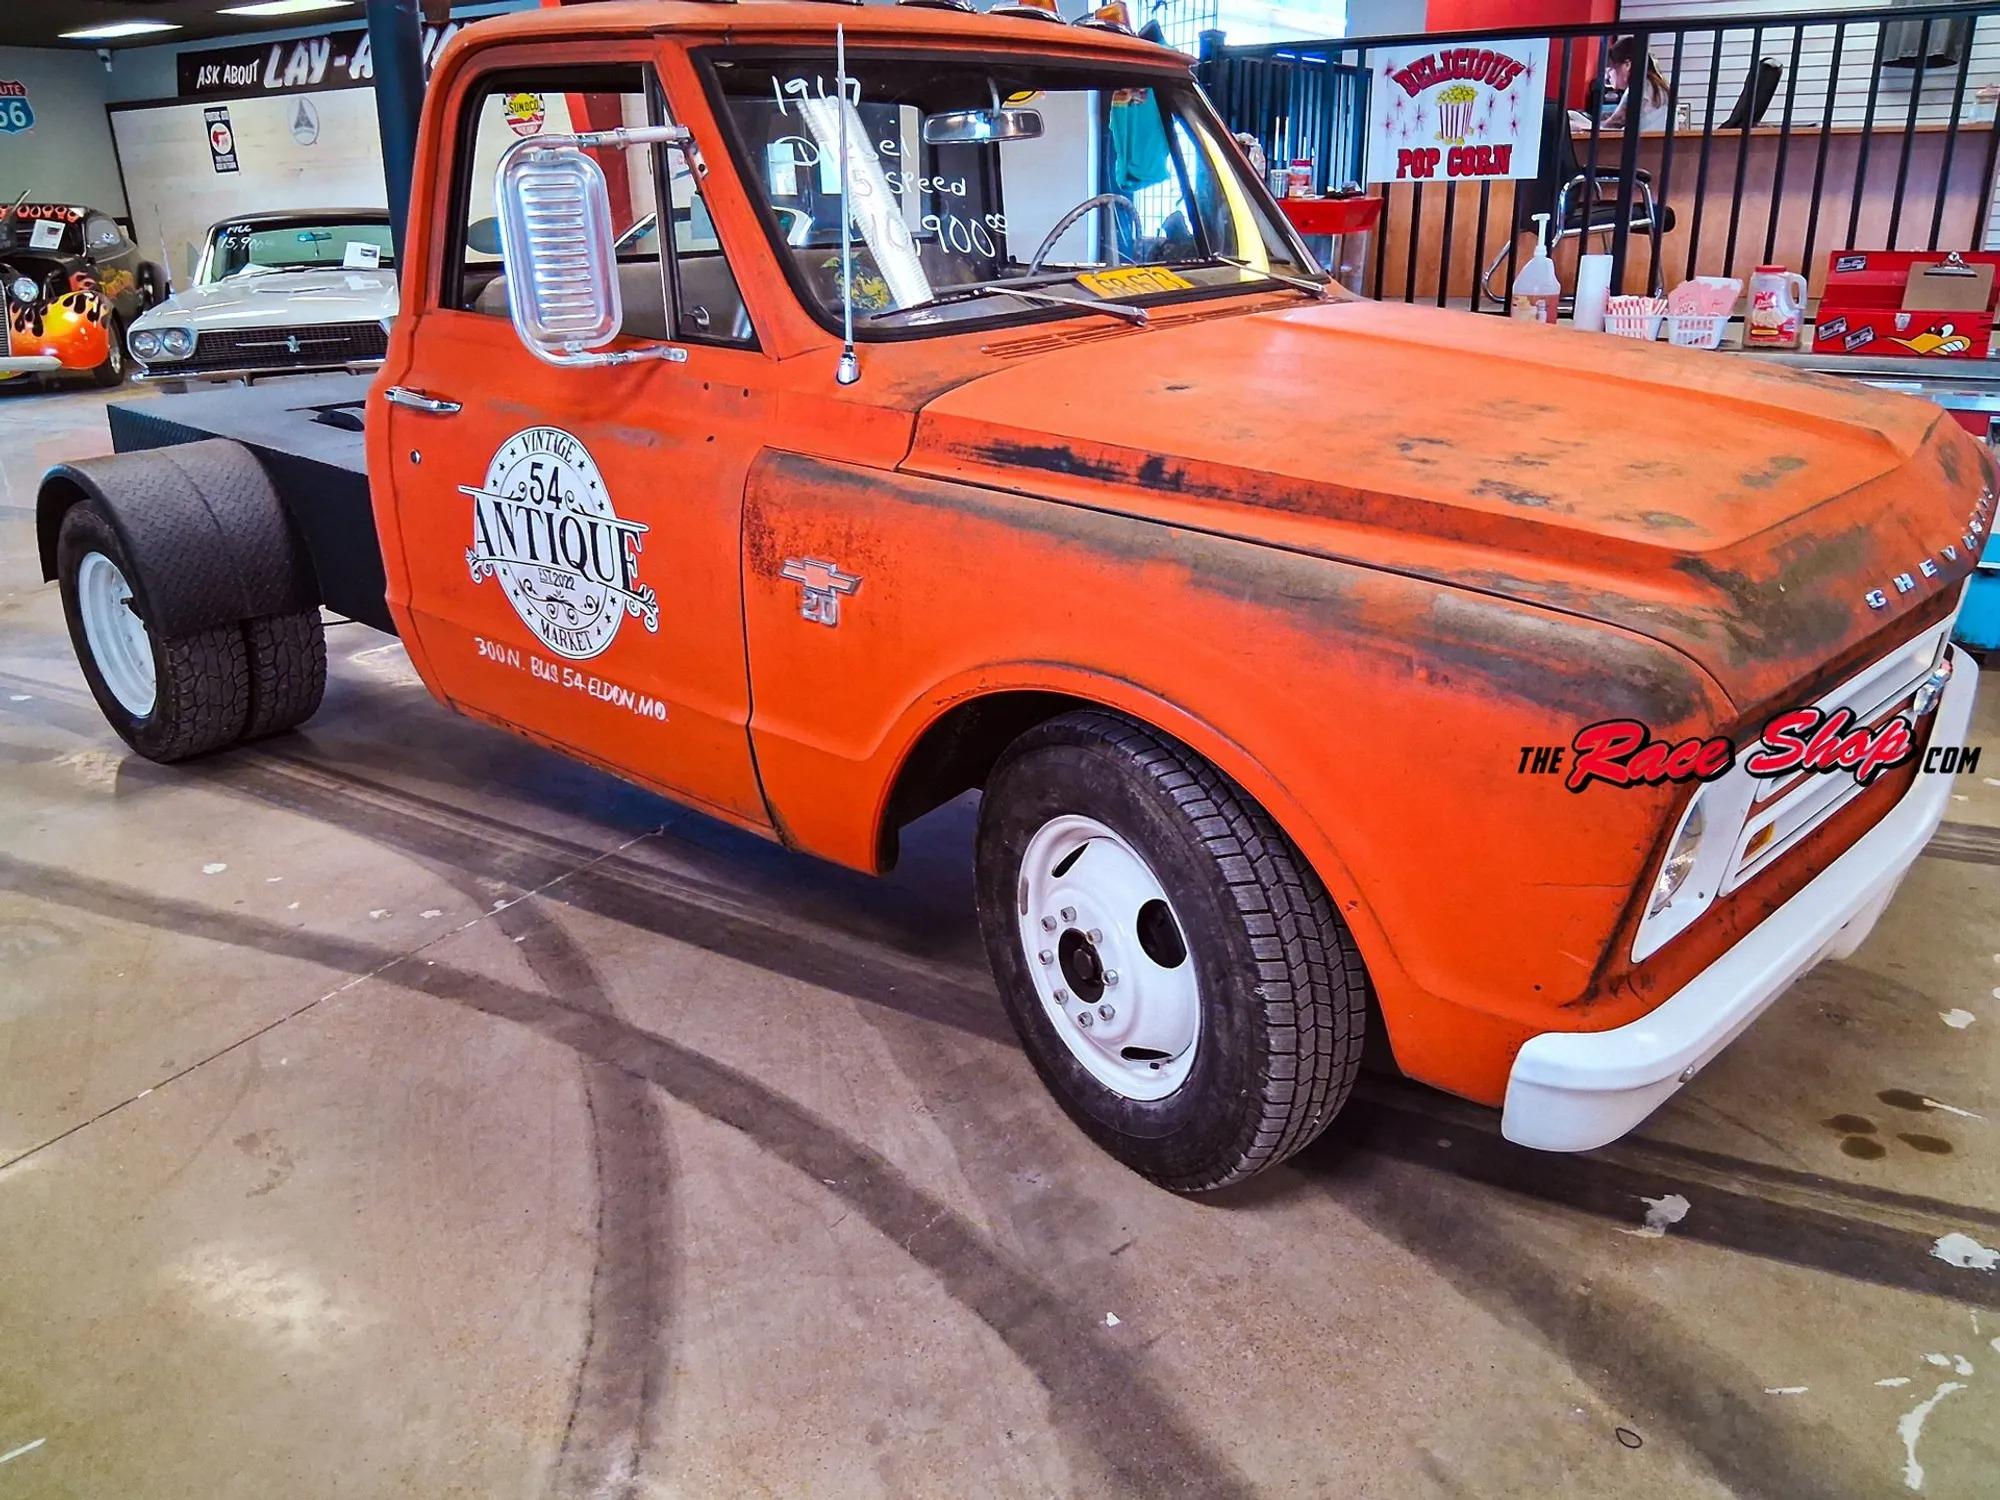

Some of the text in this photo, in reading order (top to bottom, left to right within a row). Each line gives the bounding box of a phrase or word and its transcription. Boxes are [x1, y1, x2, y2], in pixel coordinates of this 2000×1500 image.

[196, 66, 220, 89] ASK
[223, 59, 260, 86] ABOUT
[1391, 48, 1527, 98] DELICIOUS
[508, 99, 539, 114] SUNOCO
[1396, 144, 1513, 179] POP CORN
[521, 431, 577, 464] VINTAGE
[530, 461, 563, 510] 54
[476, 494, 643, 598] ANTIQUE
[540, 618, 595, 652] MARKET
[529, 655, 559, 683] BUS
